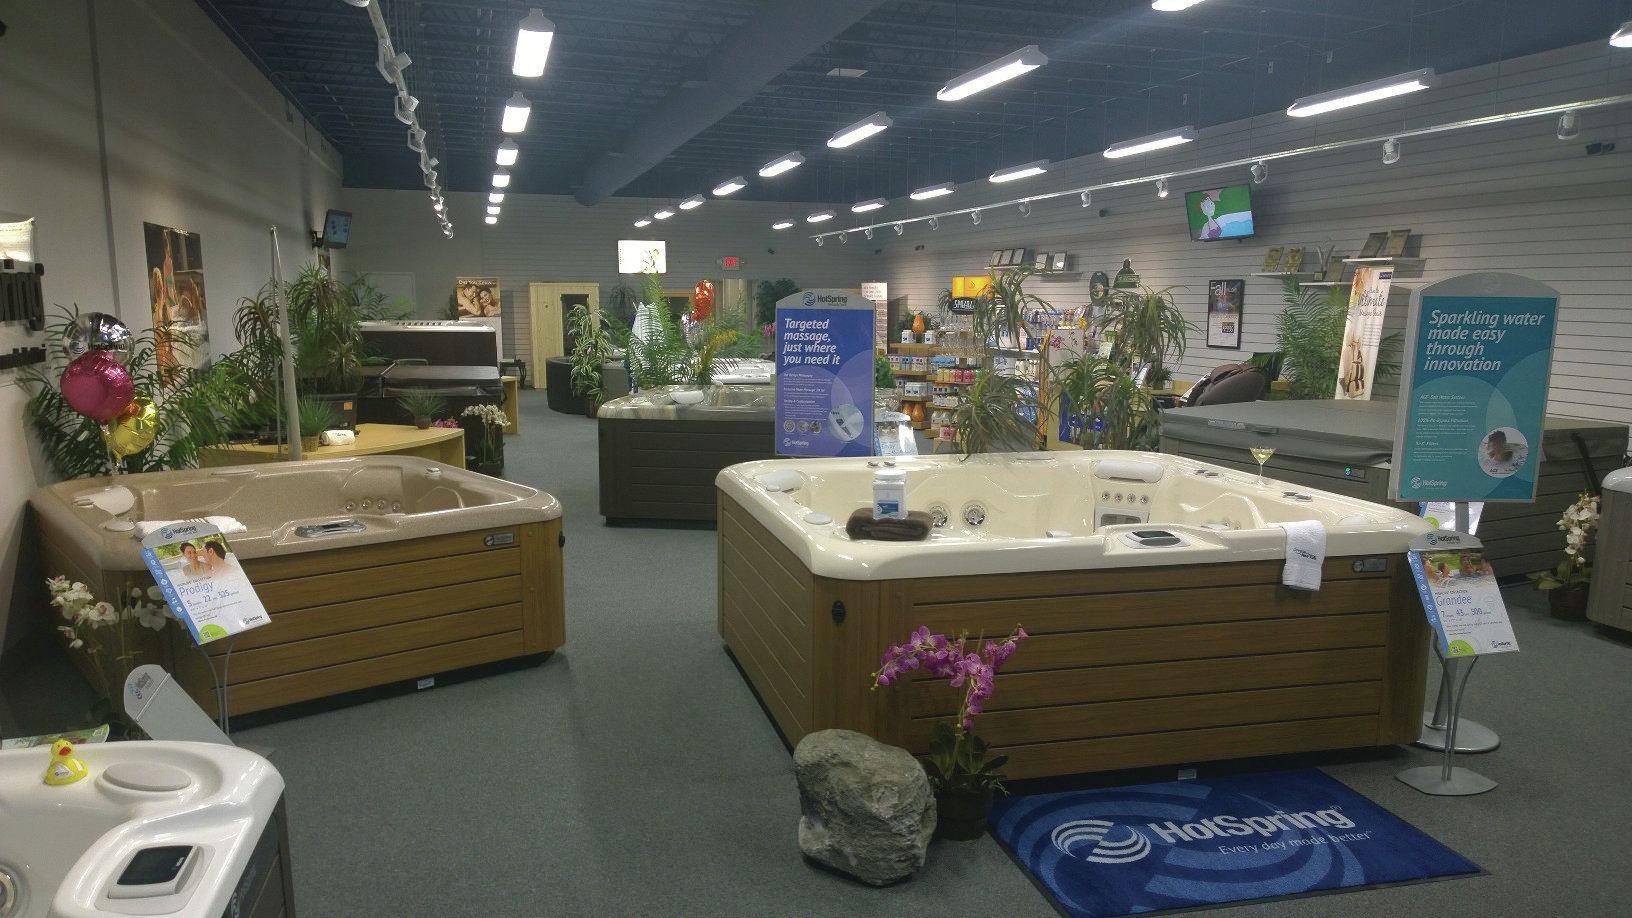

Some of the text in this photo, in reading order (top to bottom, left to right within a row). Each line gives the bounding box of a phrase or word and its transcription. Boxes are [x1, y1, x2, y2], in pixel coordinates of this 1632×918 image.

[1210, 281, 1227, 296] Fall
[817, 294, 848, 304] HotSpring
[785, 318, 830, 331] Targeted
[1429, 309, 1546, 329] Sparkling water
[783, 332, 831, 343] massage,
[1427, 325, 1507, 344] made easy
[782, 341, 837, 354] just where
[1425, 341, 1485, 359] through
[783, 354, 841, 366] you need it
[1423, 357, 1502, 371] innovation
[178, 581, 214, 596] Prodigy
[1436, 595, 1473, 607] Grandee
[1218, 831, 1371, 855] Every day made better
